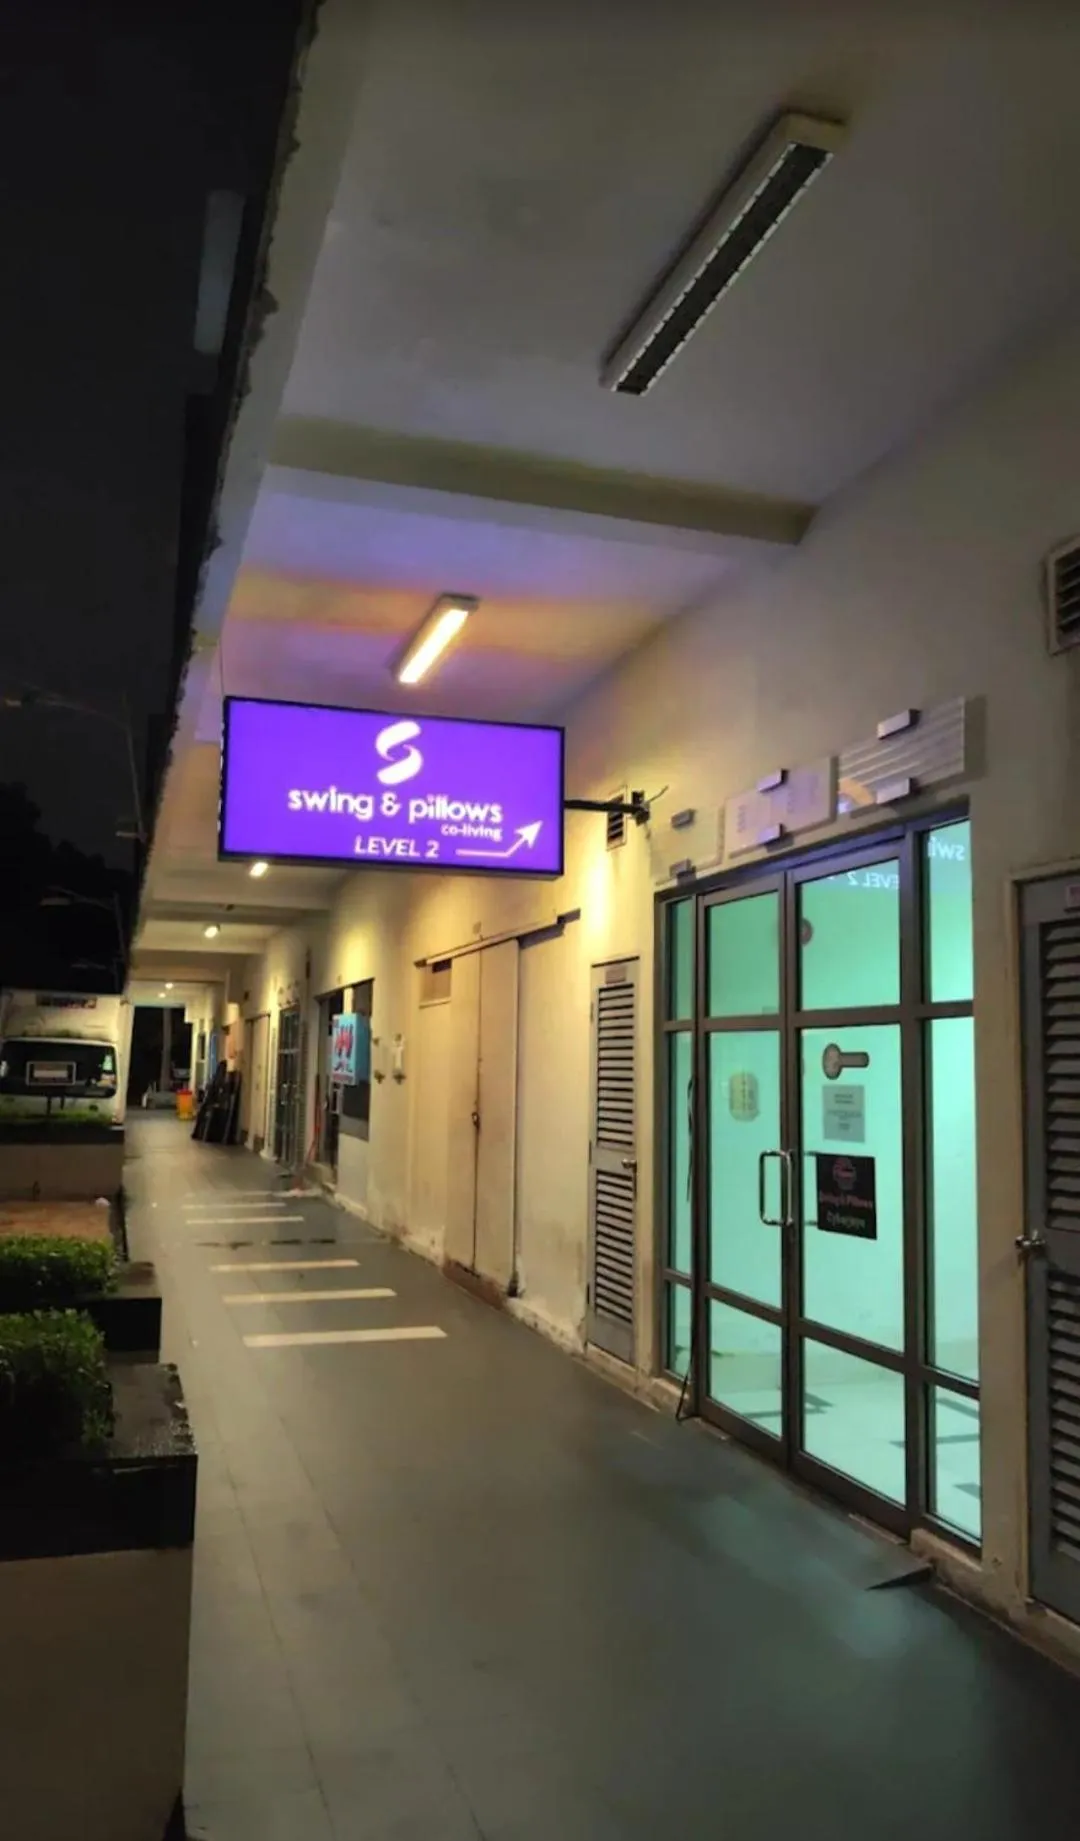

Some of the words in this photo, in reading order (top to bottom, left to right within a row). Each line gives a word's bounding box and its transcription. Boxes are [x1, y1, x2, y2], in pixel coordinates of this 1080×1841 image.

[288, 785, 374, 820] swing
[381, 792, 401, 816] &
[408, 794, 503, 824] pillows
[440, 823, 502, 841] co-living
[354, 835, 420, 857] LEVEL
[425, 840, 439, 858] 2
